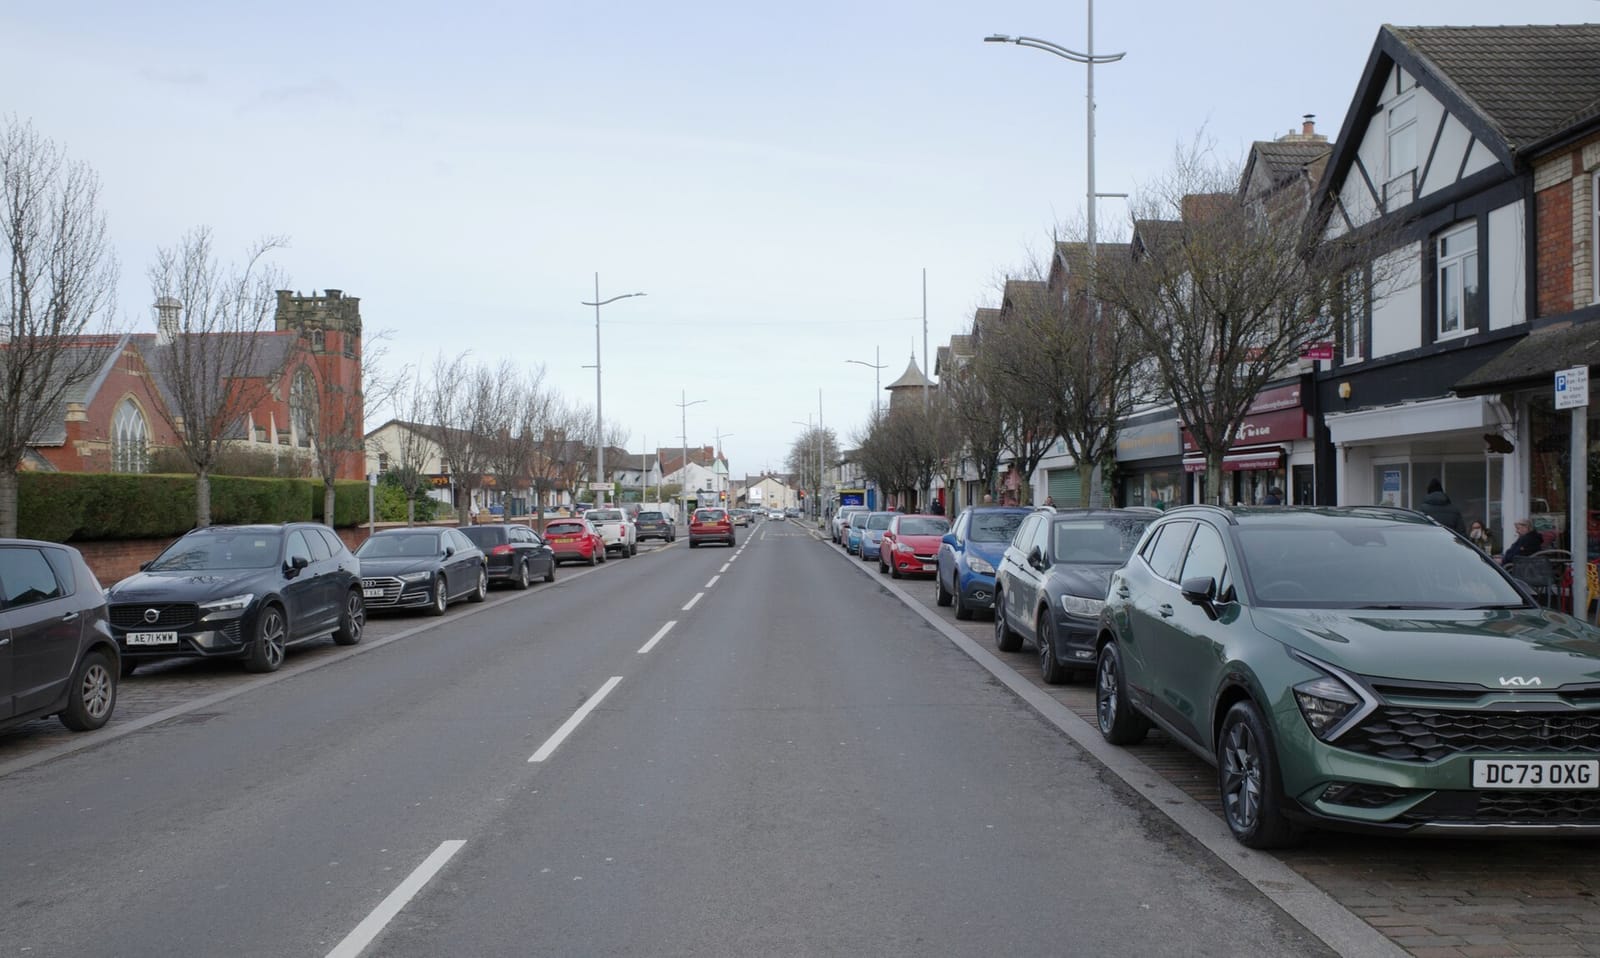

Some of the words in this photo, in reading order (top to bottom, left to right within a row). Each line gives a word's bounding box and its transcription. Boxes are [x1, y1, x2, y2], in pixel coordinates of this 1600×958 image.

[1558, 377, 1565, 390] P
[134, 634, 154, 643] AE71
[156, 632, 173, 642] KWW
[1487, 764, 1542, 784] DC73
[1550, 764, 1590, 783] OXG
